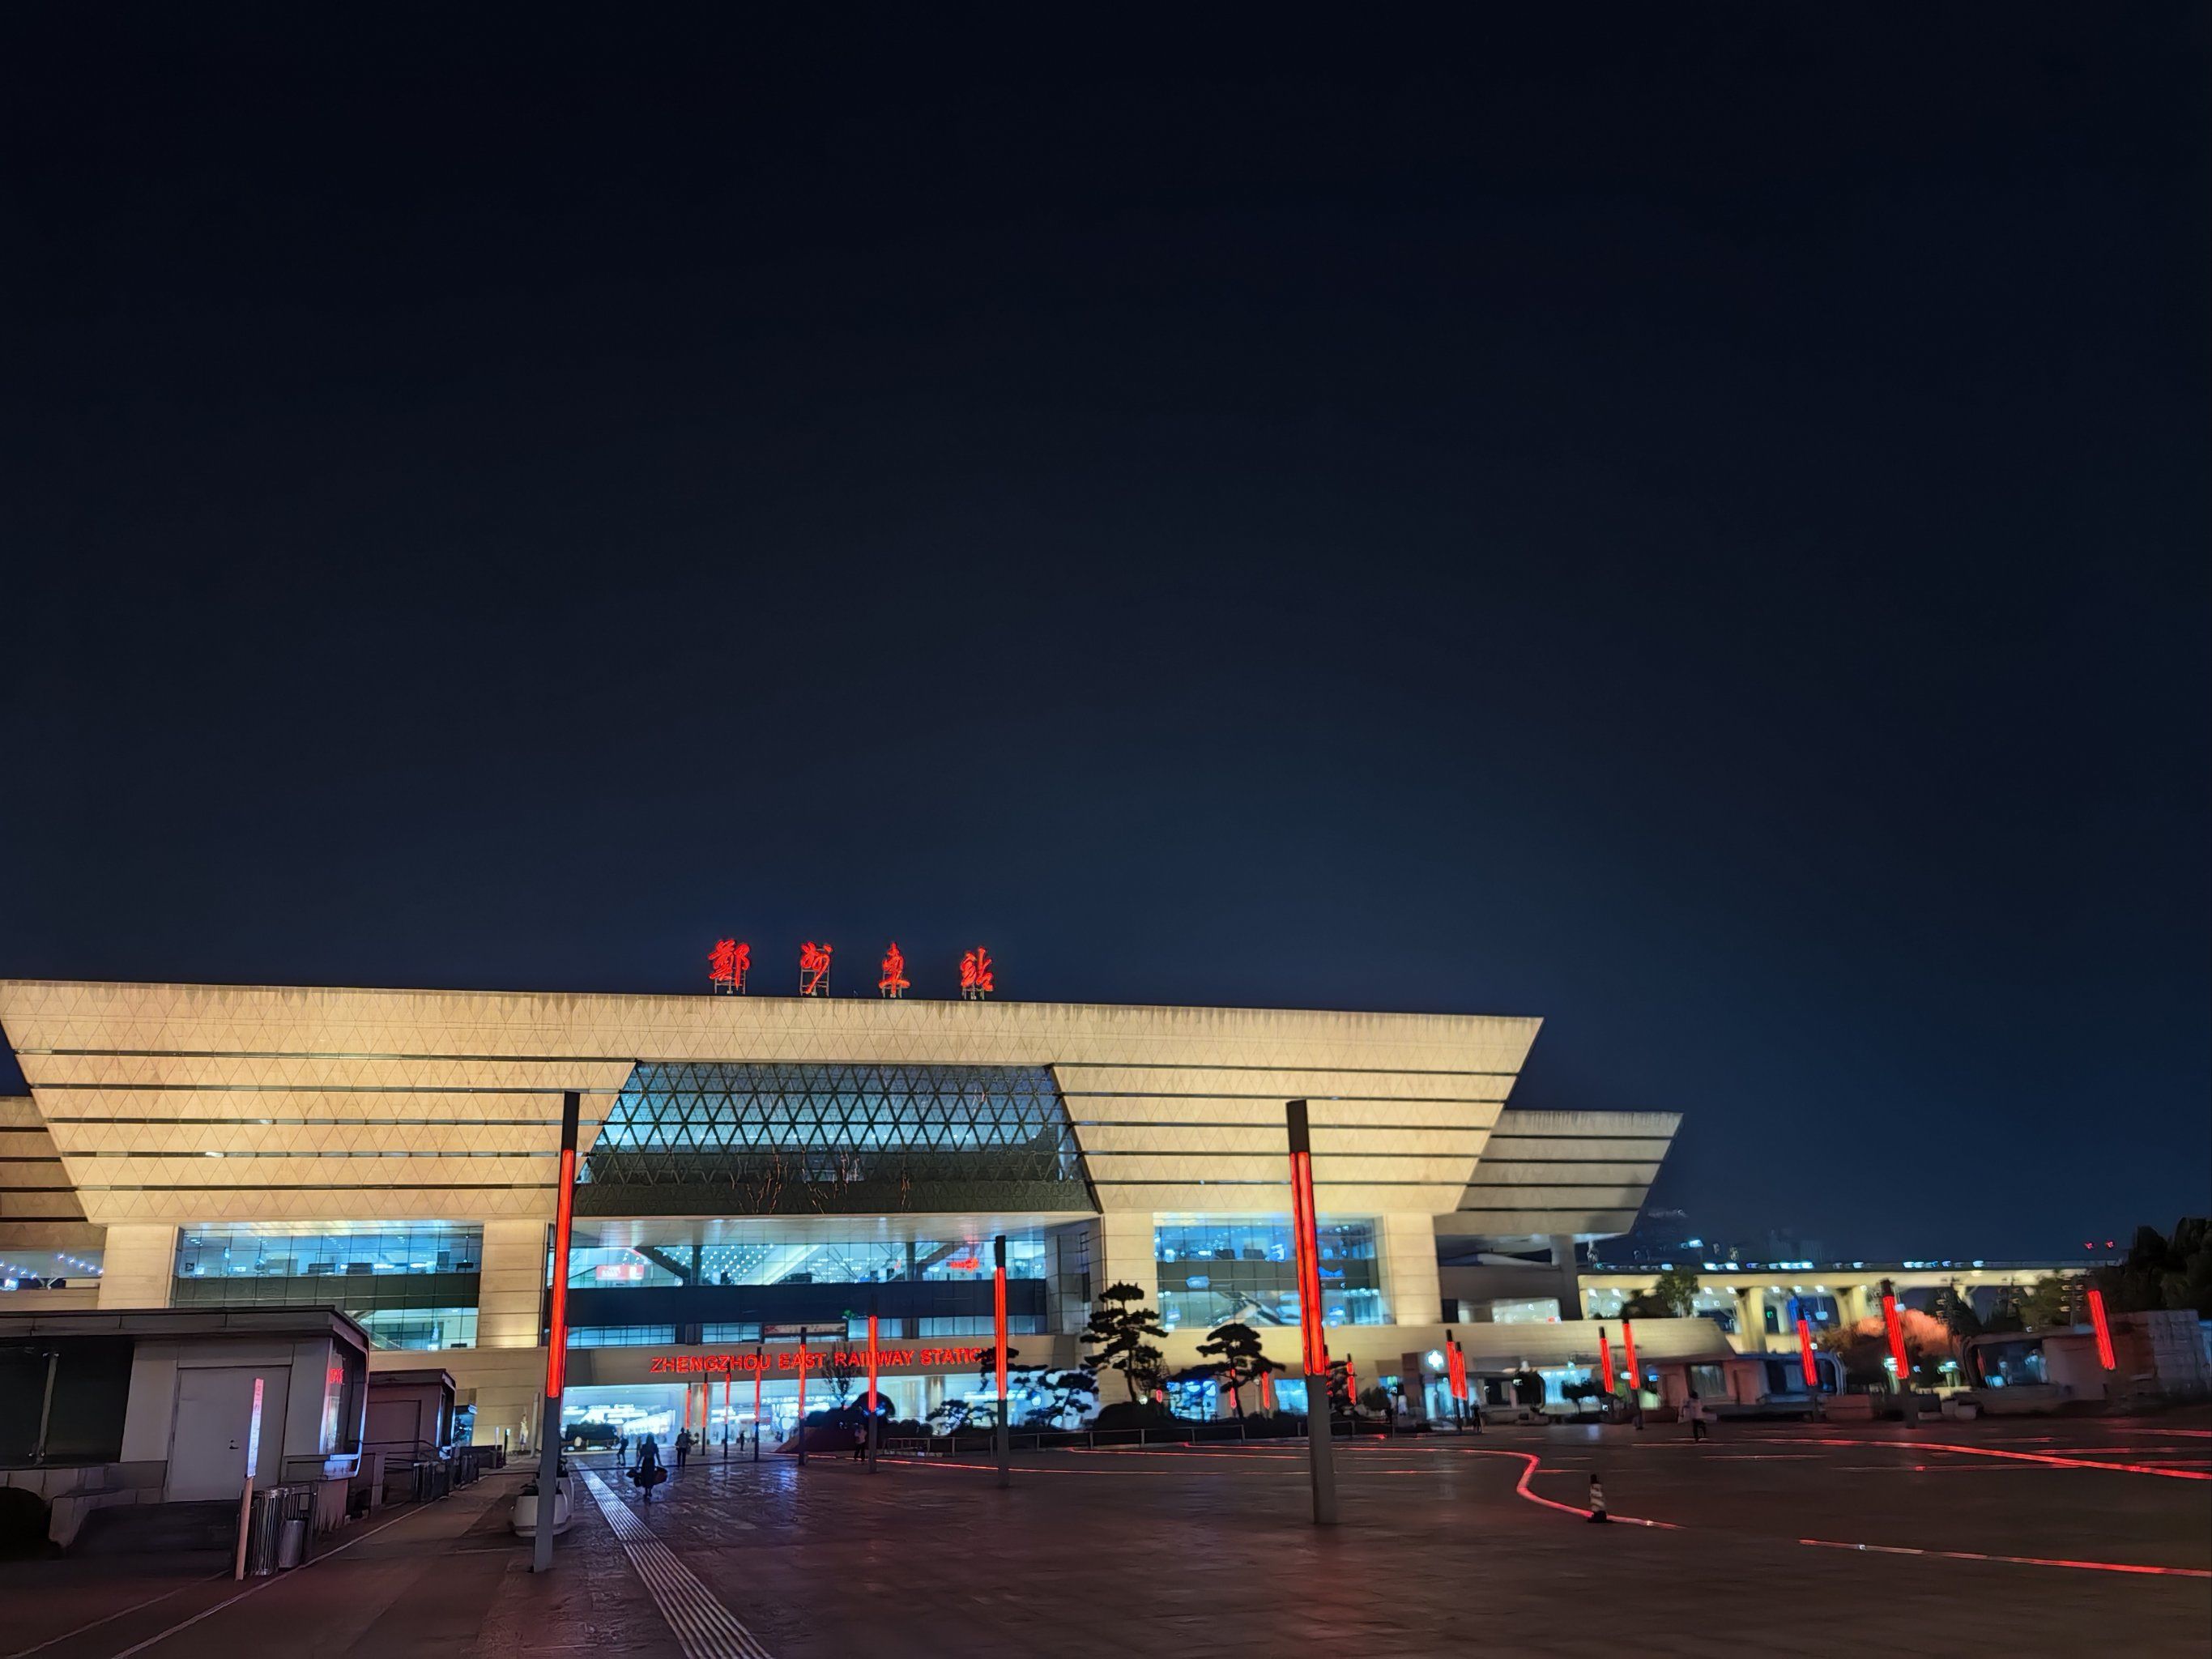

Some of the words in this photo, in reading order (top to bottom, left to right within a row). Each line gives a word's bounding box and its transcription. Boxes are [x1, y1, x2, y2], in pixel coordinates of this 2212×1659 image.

[650, 1354, 771, 1373] ZHENGZHOU
[778, 1352, 827, 1370] EAST
[920, 1347, 989, 1366] STATIO
